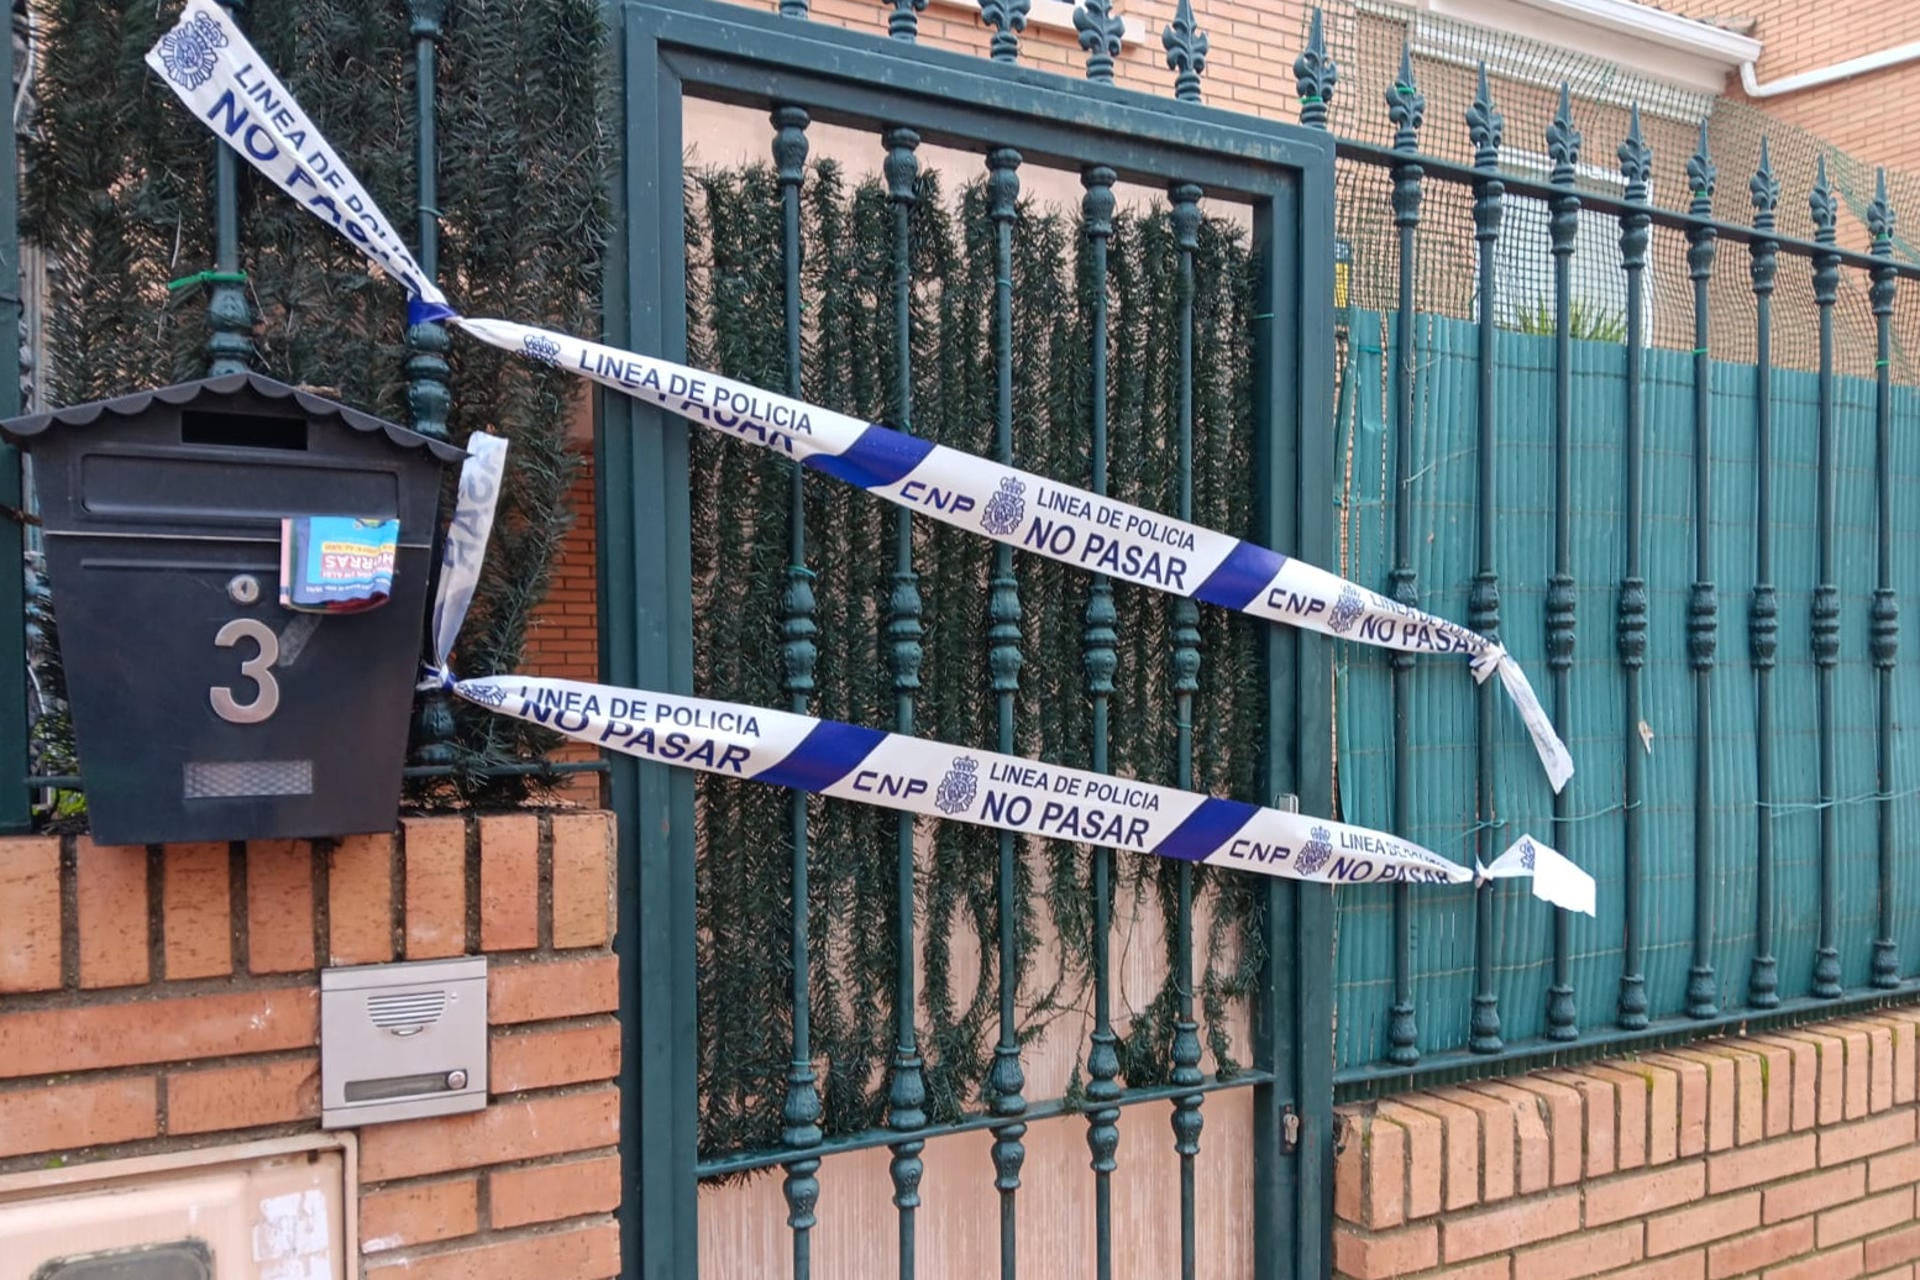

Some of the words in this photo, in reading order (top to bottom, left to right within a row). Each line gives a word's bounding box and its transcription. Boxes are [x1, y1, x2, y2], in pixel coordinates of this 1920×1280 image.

[206, 88, 280, 161] NO
[233, 63, 306, 150] LINEA
[578, 349, 661, 390] LINEA
[668, 373, 707, 402] DE
[713, 387, 813, 435] POLICIA
[899, 480, 976, 515] CNP
[1037, 486, 1091, 521] LINEA
[1096, 505, 1123, 530] DE
[1126, 515, 1195, 552] POLICIA
[1024, 516, 1076, 555] NO
[1080, 533, 1188, 590] PASAR
[1267, 588, 1325, 616] CNP
[1359, 613, 1397, 642] NO
[210, 618, 279, 723] 3
[519, 700, 590, 732] NO
[600, 720, 751, 773] PASAR
[610, 698, 648, 721] DE
[655, 704, 761, 738] POLICIA
[853, 770, 928, 799] CNP
[989, 762, 1049, 791] LINEA
[1053, 775, 1082, 798] DE
[1084, 781, 1160, 811] POLICIA
[980, 790, 1032, 826] NO
[1038, 802, 1150, 847] PASAR
[1340, 831, 1386, 855] LINEA
[1229, 839, 1290, 864] CNP
[1328, 857, 1373, 881] NO
